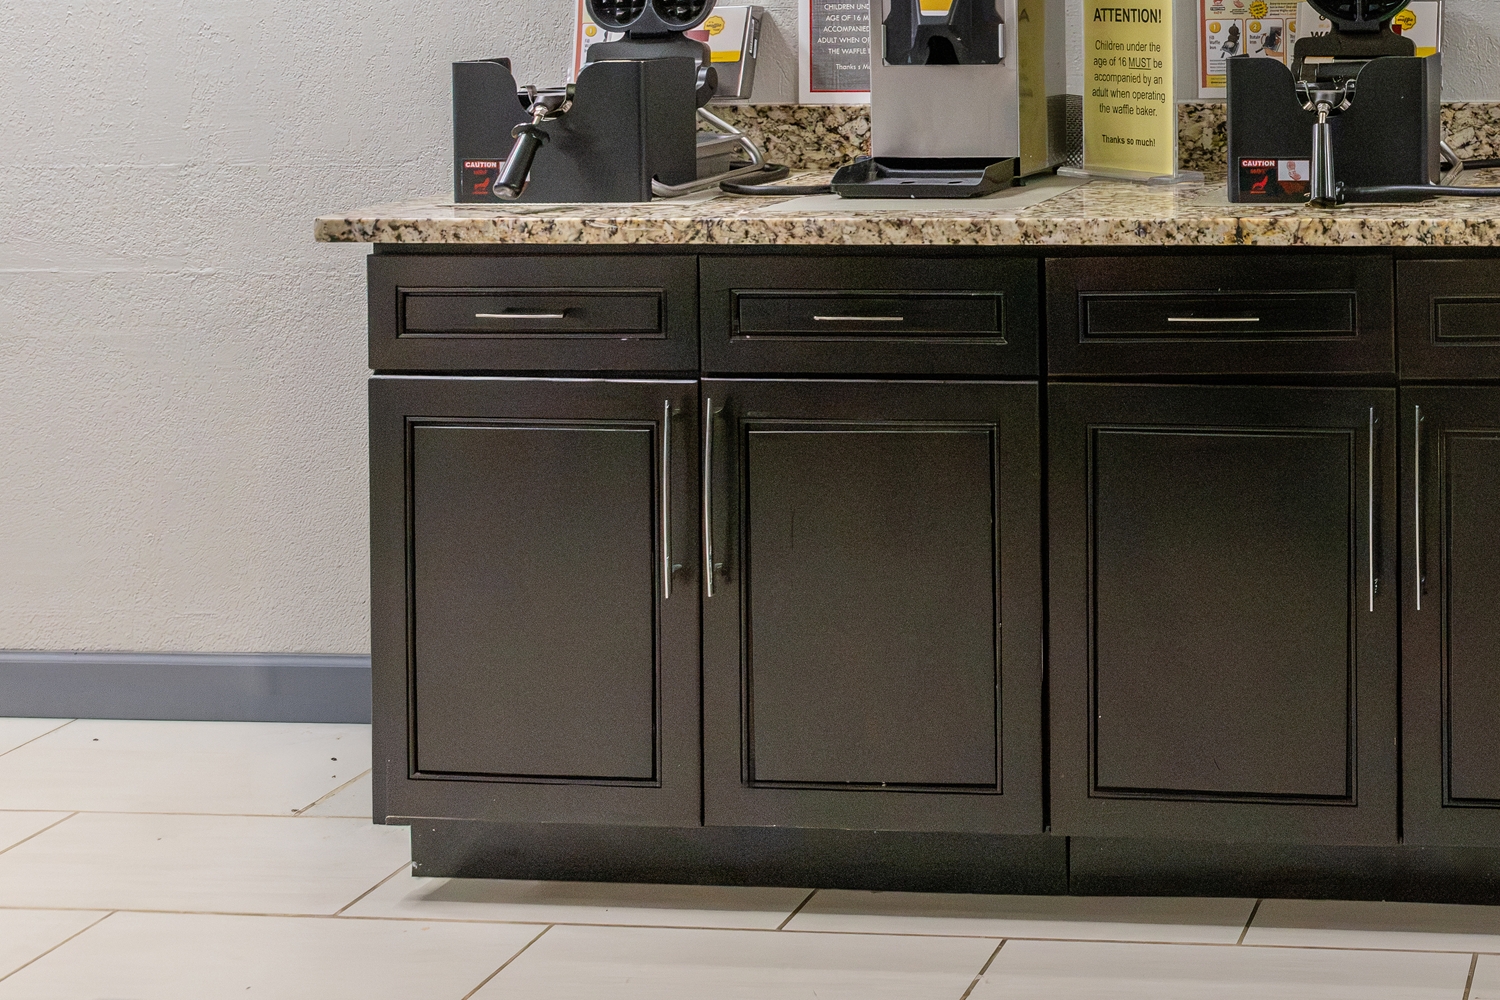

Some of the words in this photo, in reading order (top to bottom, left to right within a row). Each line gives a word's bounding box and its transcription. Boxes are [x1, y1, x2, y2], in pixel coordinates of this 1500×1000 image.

[1093, 8, 1162, 23] ATTENTION!
[1095, 40, 1125, 51] Children
[1126, 42, 1148, 52] under
[1149, 42, 1161, 53] the
[1093, 57, 1107, 68] age
[1108, 56, 1117, 66] of
[1118, 56, 1127, 67] 16
[1128, 57, 1152, 68] MUST
[1153, 58, 1163, 69] be
[1094, 73, 1142, 85] accompanied
[1142, 73, 1152, 87] by
[1153, 76, 1163, 85] an
[1092, 86, 1109, 98] adult
[1110, 88, 1131, 99] when
[1132, 90, 1166, 104] operating
[1099, 103, 1111, 114] the
[1112, 104, 1134, 115] waffle
[1136, 105, 1158, 117] baker.
[1102, 134, 1126, 145] Thanks
[1127, 137, 1135, 145] so
[1136, 138, 1156, 147] much!
